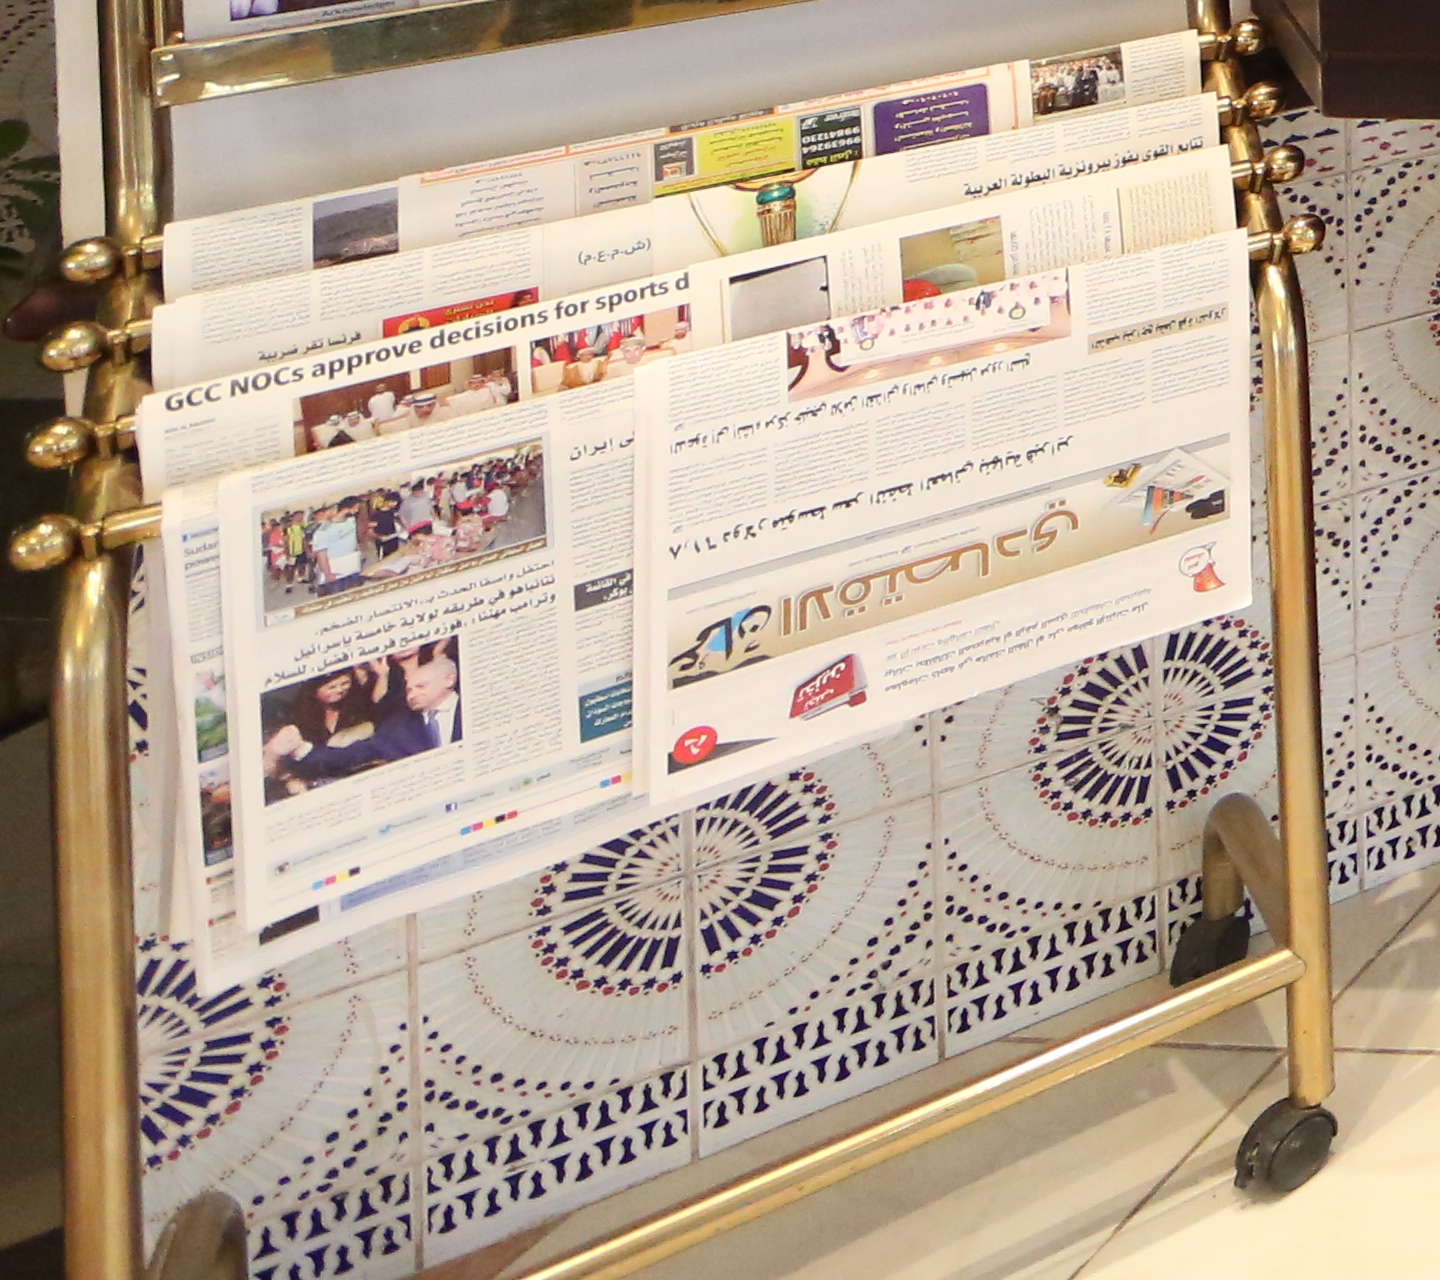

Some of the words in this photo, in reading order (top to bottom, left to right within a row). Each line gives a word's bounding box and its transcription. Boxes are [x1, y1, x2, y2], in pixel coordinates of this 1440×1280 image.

[164, 387, 221, 411] GCC
[229, 367, 304, 396] NOCs
[311, 340, 422, 380] approve
[429, 310, 548, 349] decisions
[553, 300, 588, 319] for
[594, 282, 669, 313] sports
[780, 499, 1080, 636] الاقتصادي
